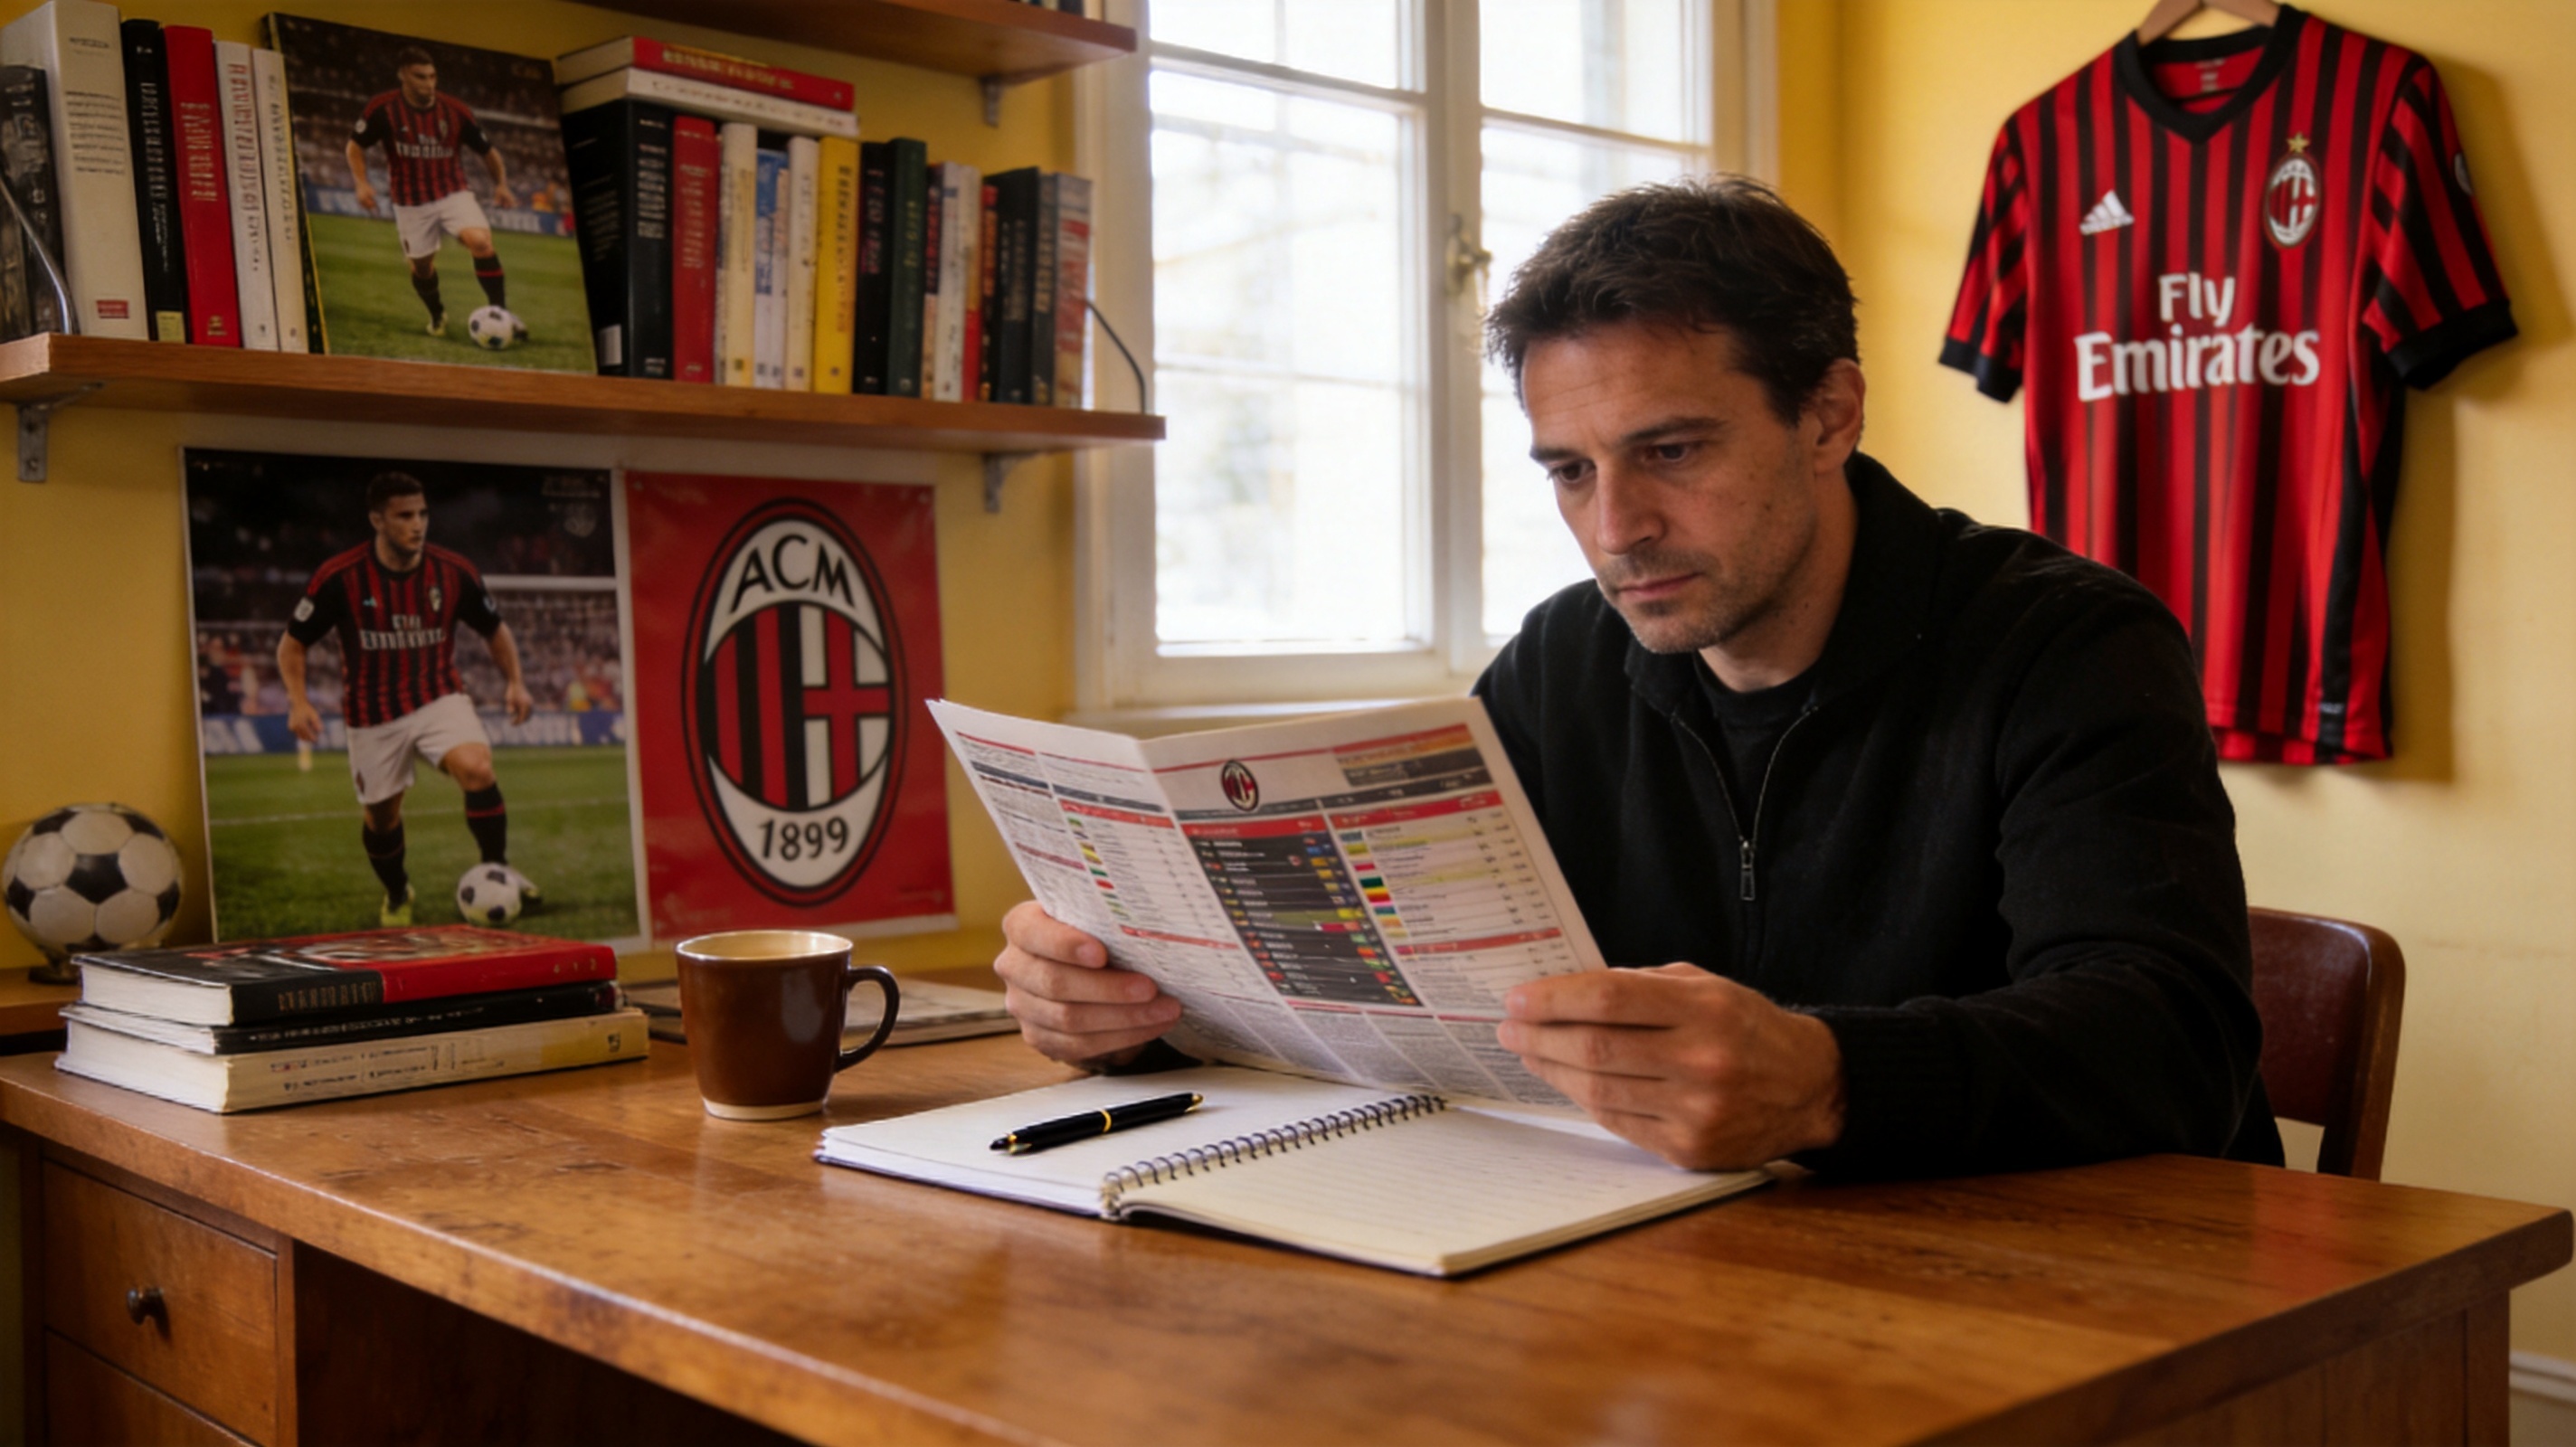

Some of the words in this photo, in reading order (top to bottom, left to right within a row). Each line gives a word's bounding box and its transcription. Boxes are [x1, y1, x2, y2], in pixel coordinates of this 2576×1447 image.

[2158, 271, 2235, 327] Fly
[2074, 322, 2320, 402] Emirates
[729, 534, 855, 613] ACM
[758, 817, 848, 862] 1899
